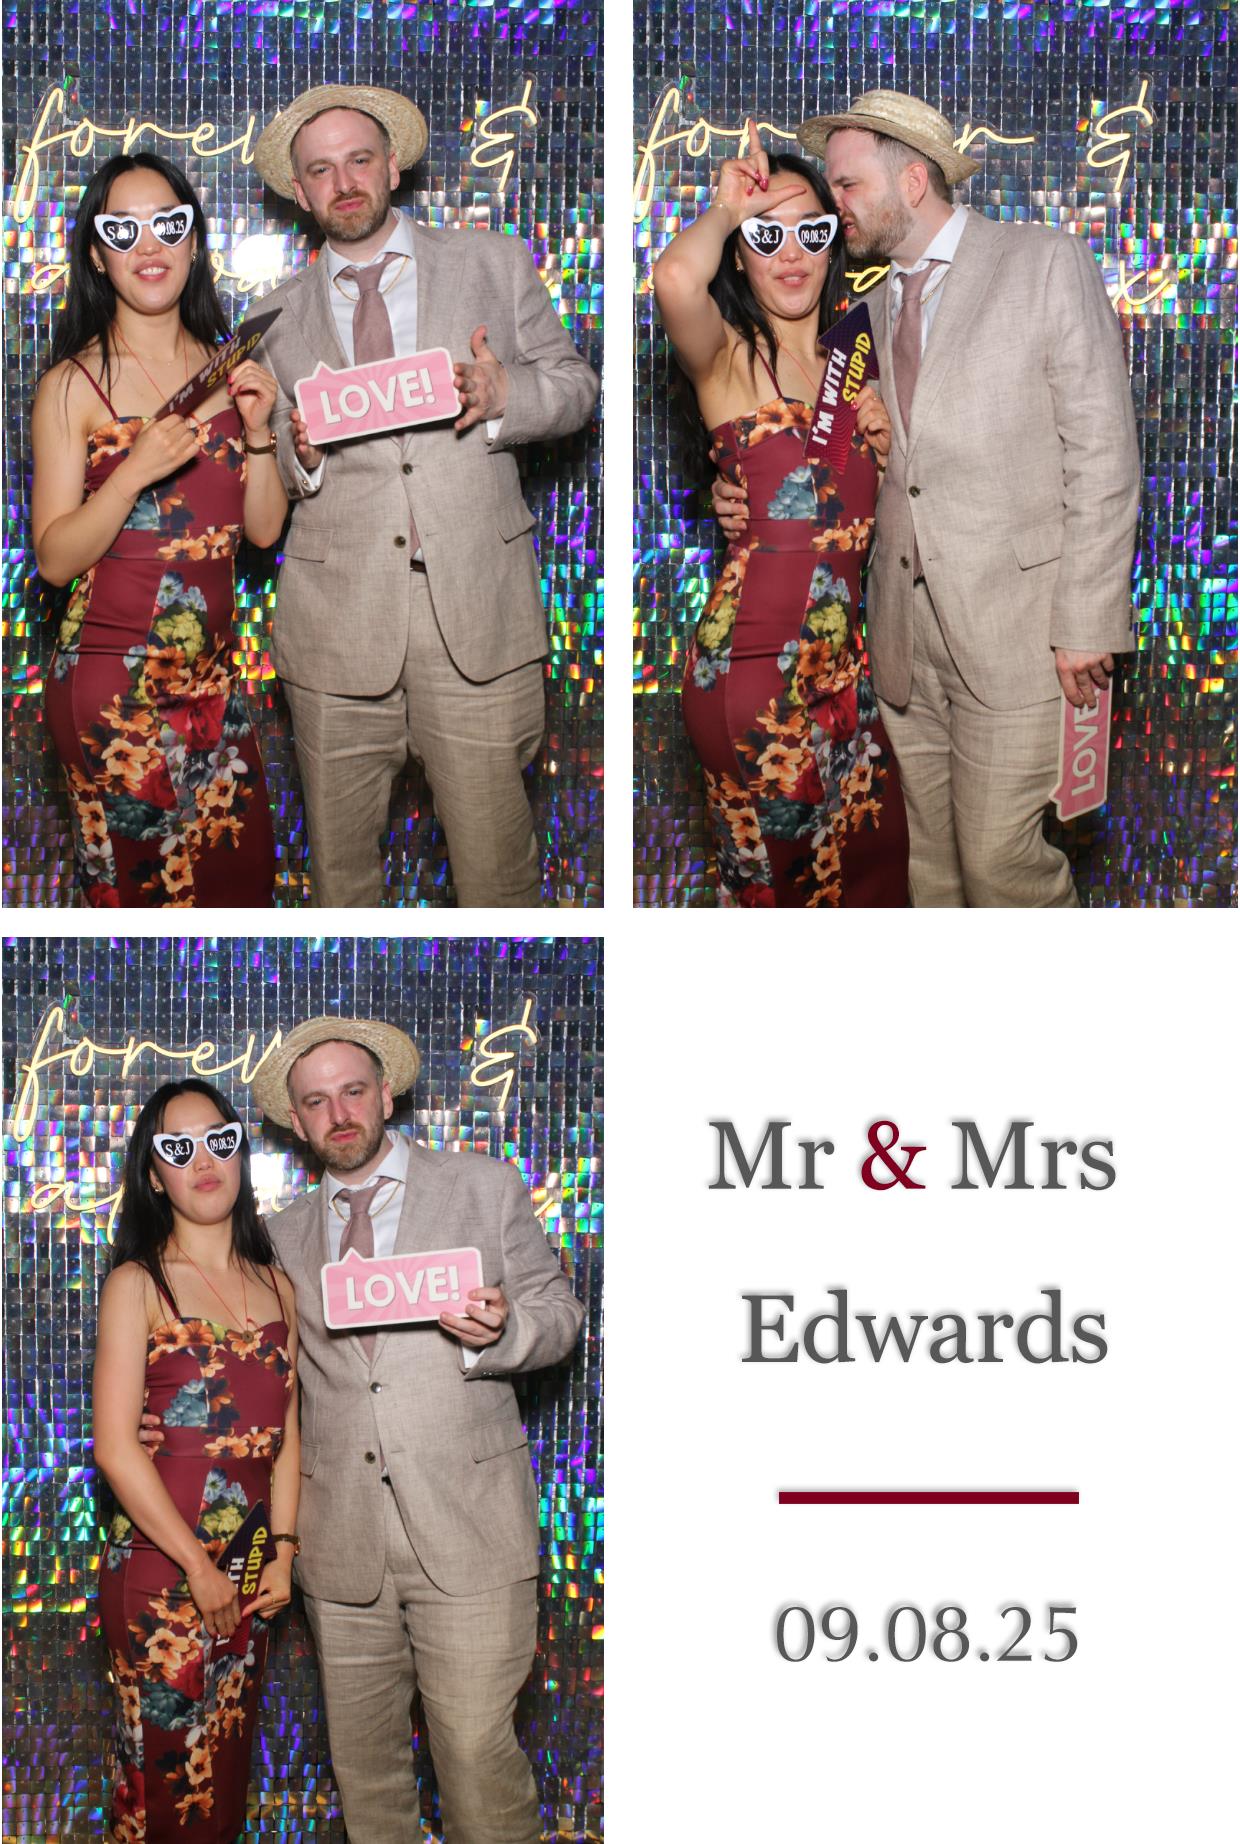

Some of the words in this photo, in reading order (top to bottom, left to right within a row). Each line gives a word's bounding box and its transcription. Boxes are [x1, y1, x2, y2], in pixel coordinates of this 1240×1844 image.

[800, 229, 828, 244] 09.08.25
[199, 335, 241, 383] WITH
[206, 332, 261, 388] STUPID
[822, 347, 848, 407] WITH
[842, 331, 872, 403] STUPID
[319, 367, 437, 425] LOVE!
[811, 410, 834, 446] I'M
[209, 1135, 235, 1152] 09.08.25
[345, 1265, 461, 1311] LOVE!
[241, 1526, 268, 1596] STUPID
